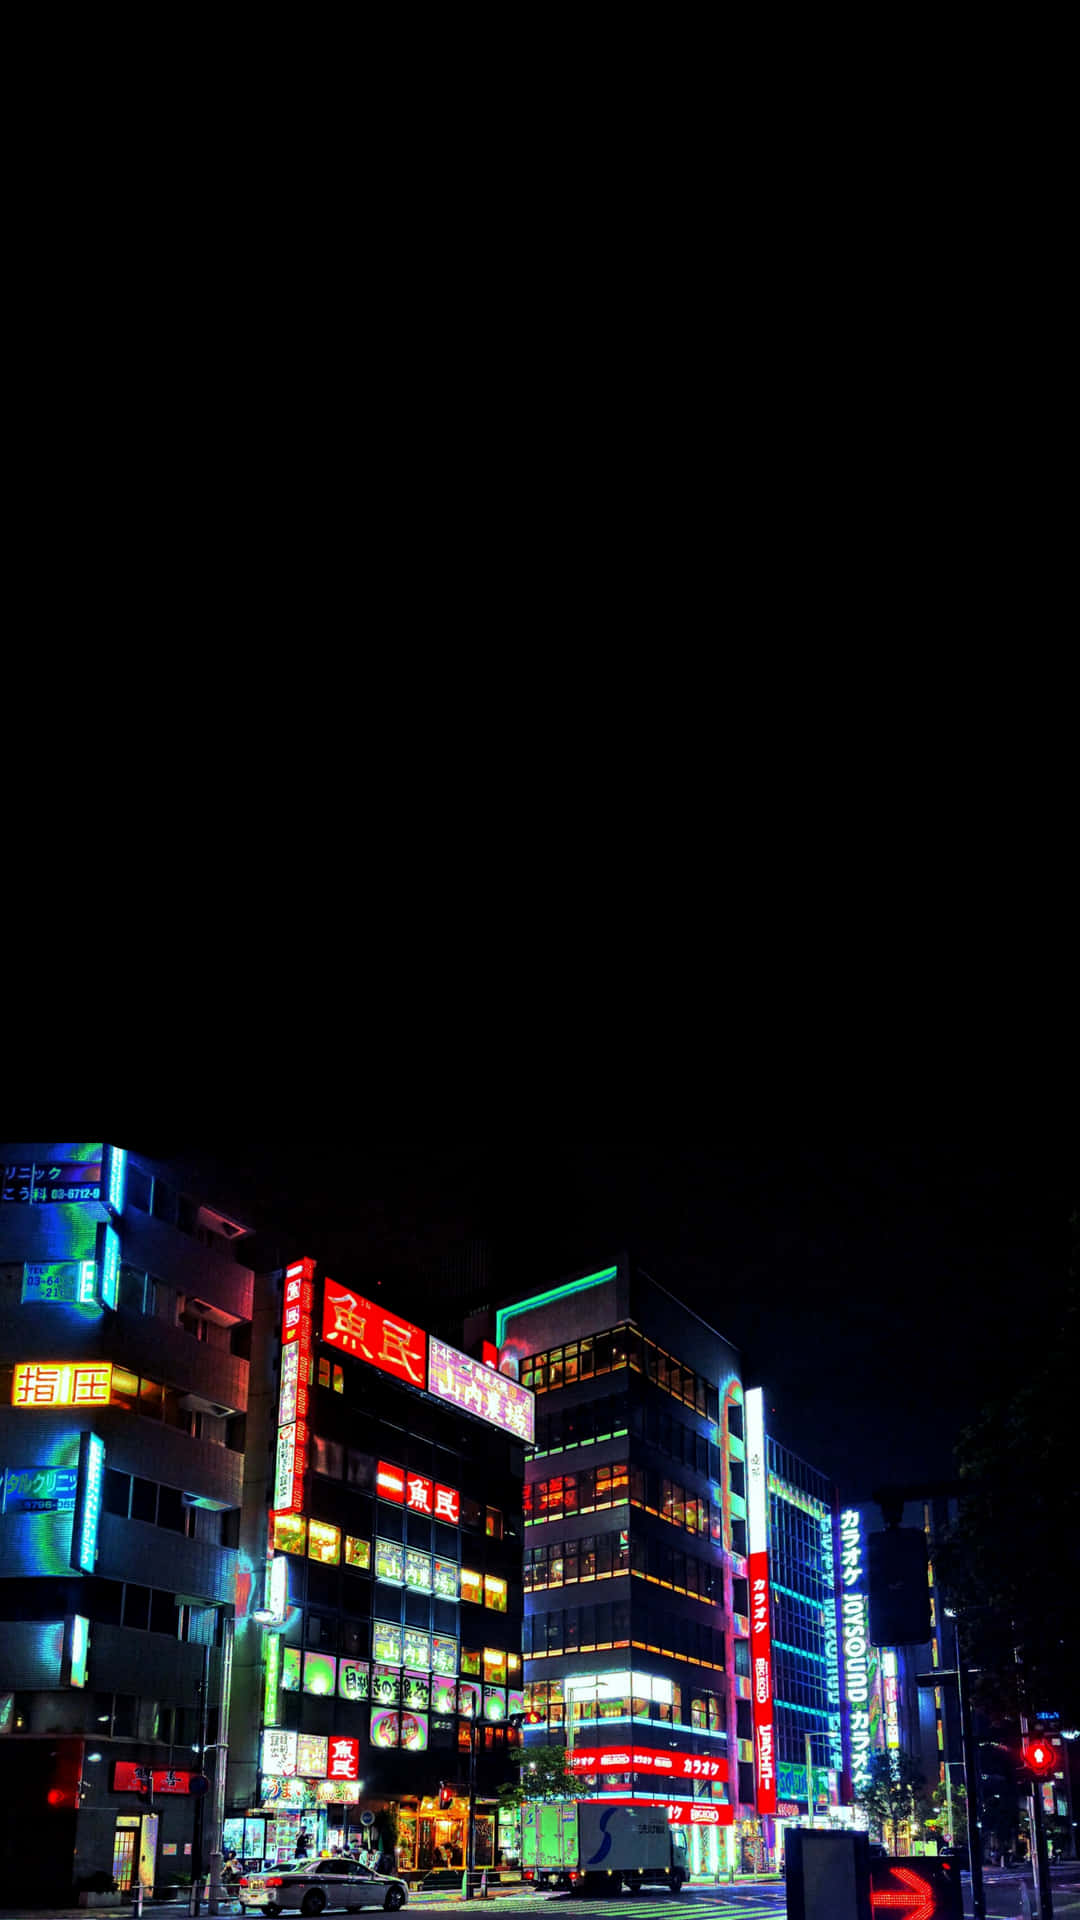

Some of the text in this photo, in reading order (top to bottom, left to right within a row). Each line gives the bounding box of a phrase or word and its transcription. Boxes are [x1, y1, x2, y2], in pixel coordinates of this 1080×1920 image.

[327, 1294, 422, 1383] 魚民
[17, 1367, 109, 1402] 指圧
[407, 1479, 458, 1521] 魚民
[841, 1509, 863, 1586] カラオケ
[753, 1579, 767, 1634] カラオケ
[843, 1594, 868, 1703] JOYSOUND
[331, 1740, 356, 1778] 魚民
[683, 1758, 720, 1776] カラオケ
